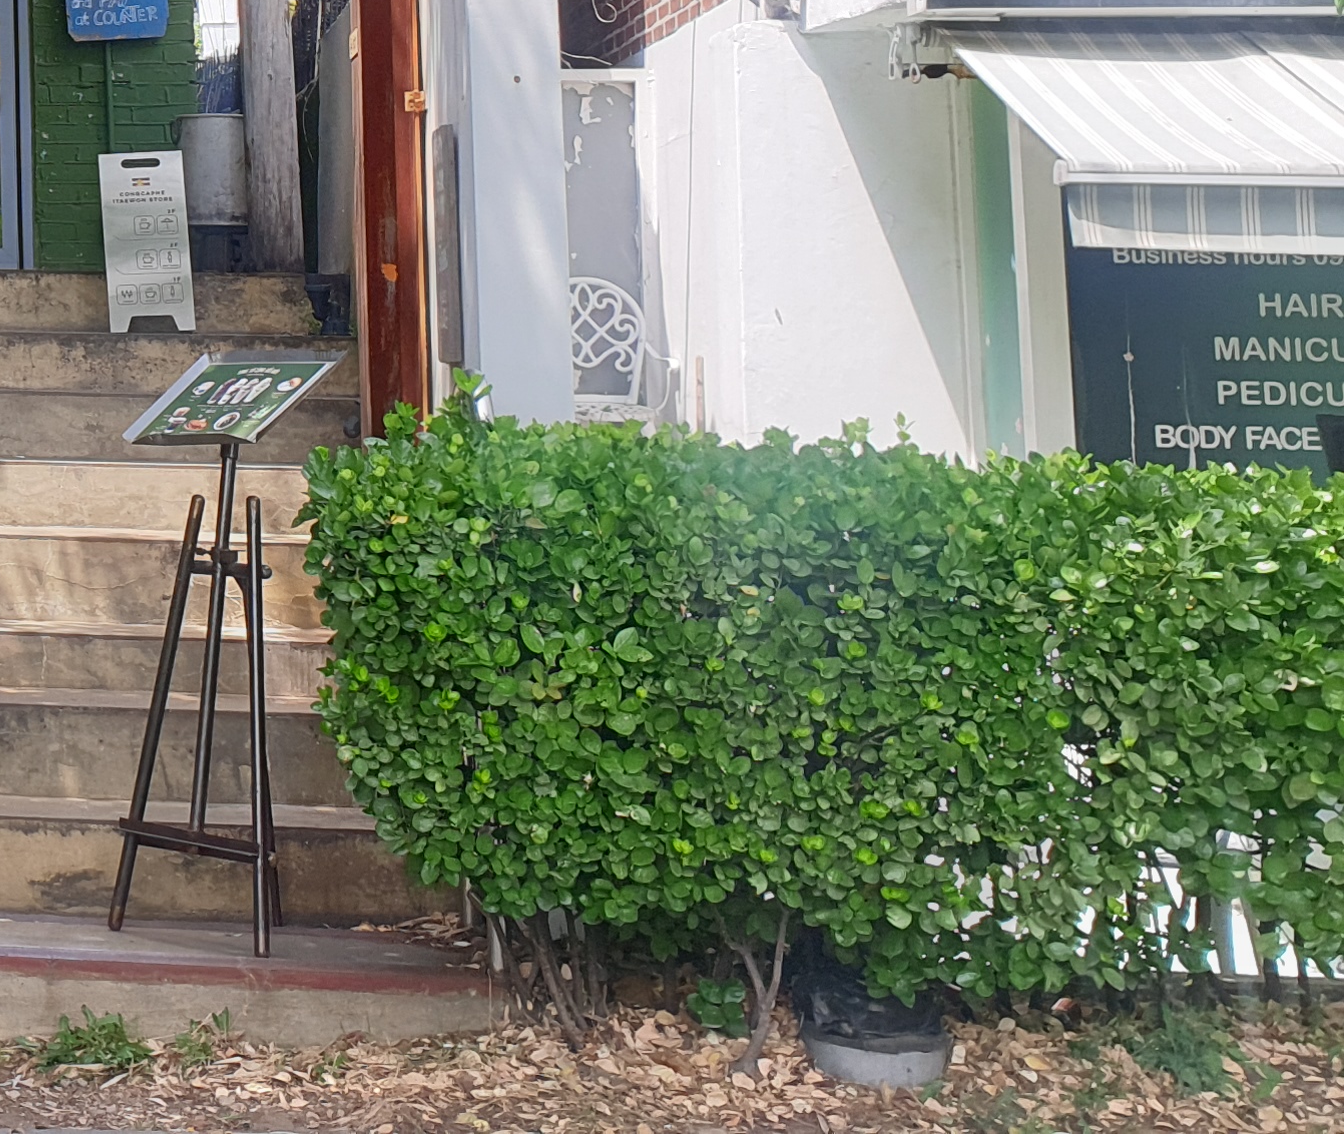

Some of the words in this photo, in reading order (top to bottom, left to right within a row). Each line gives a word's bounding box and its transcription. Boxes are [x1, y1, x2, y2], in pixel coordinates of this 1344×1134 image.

[75, 12, 90, 26] at
[93, 5, 159, 26] COUNTER
[1111, 247, 1227, 265] Business
[1258, 293, 1344, 318] HAIR
[1217, 380, 1344, 407] PEDICU
[1154, 424, 1237, 450] BODY
[1245, 426, 1323, 451] FACE
